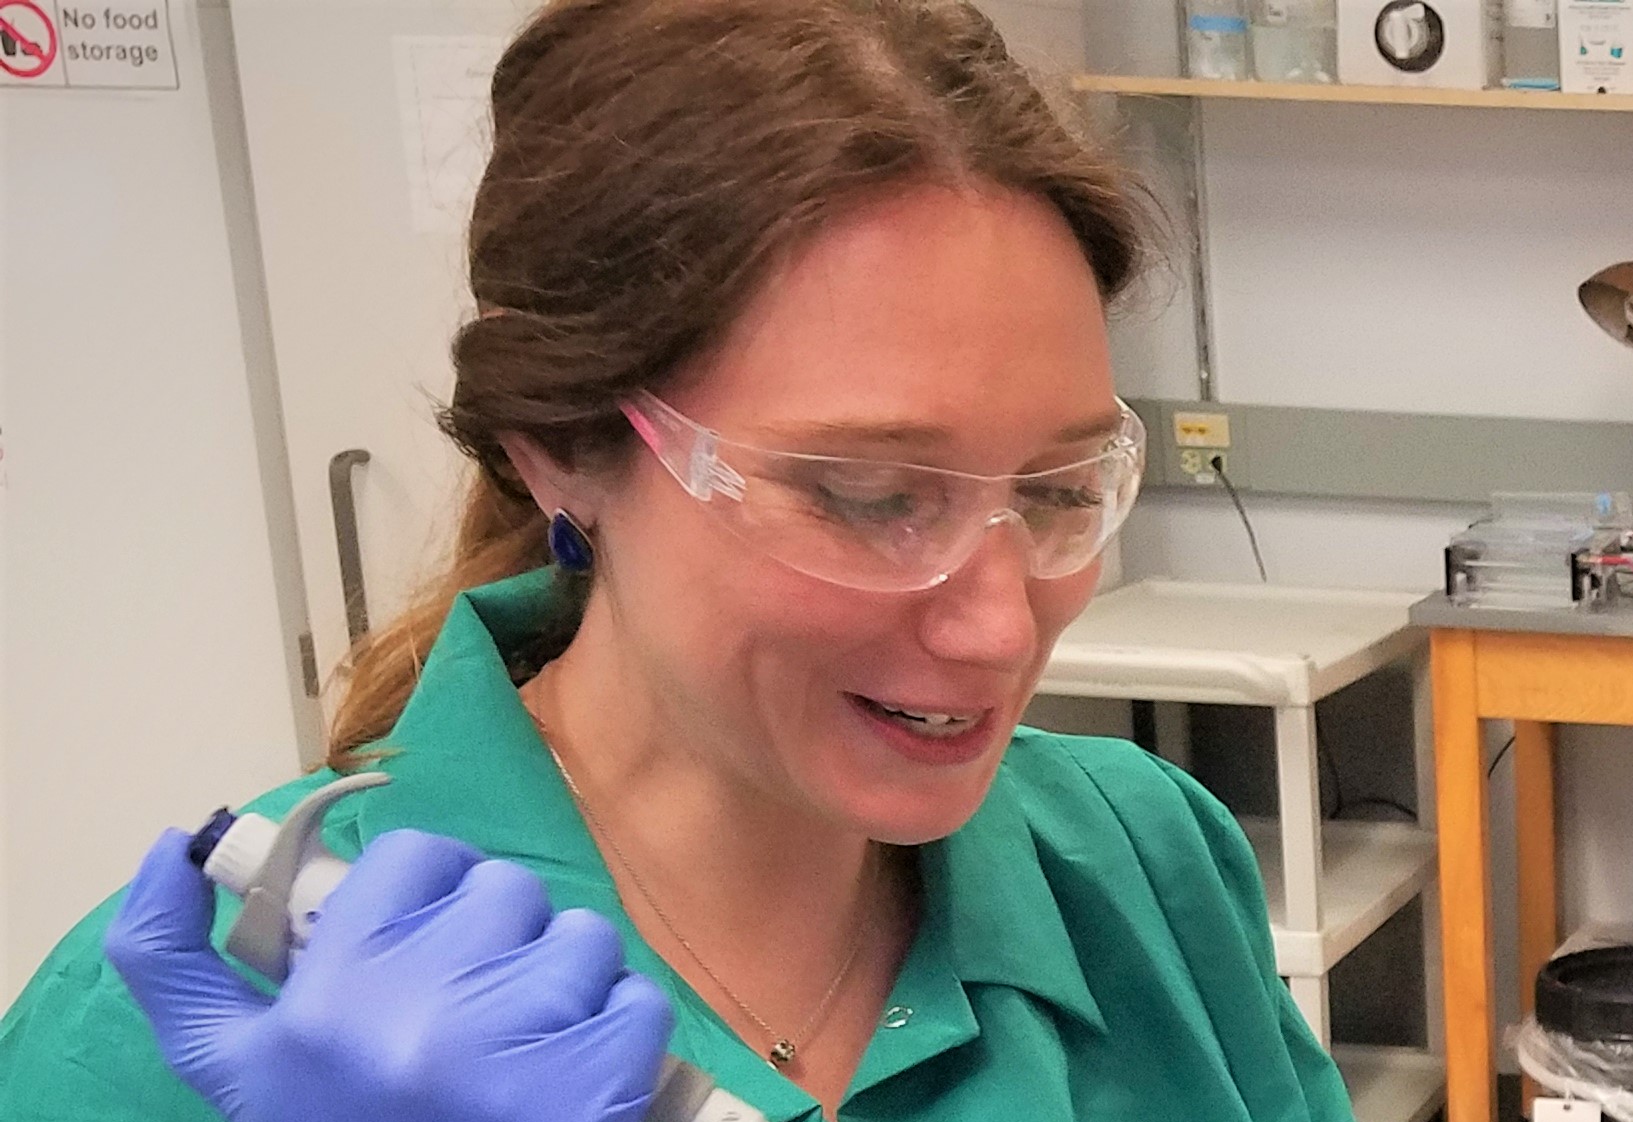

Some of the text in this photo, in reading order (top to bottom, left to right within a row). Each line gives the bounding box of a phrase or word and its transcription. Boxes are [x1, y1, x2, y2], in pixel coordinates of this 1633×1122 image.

[63, 8, 158, 30] No food
[67, 42, 158, 67] storage
